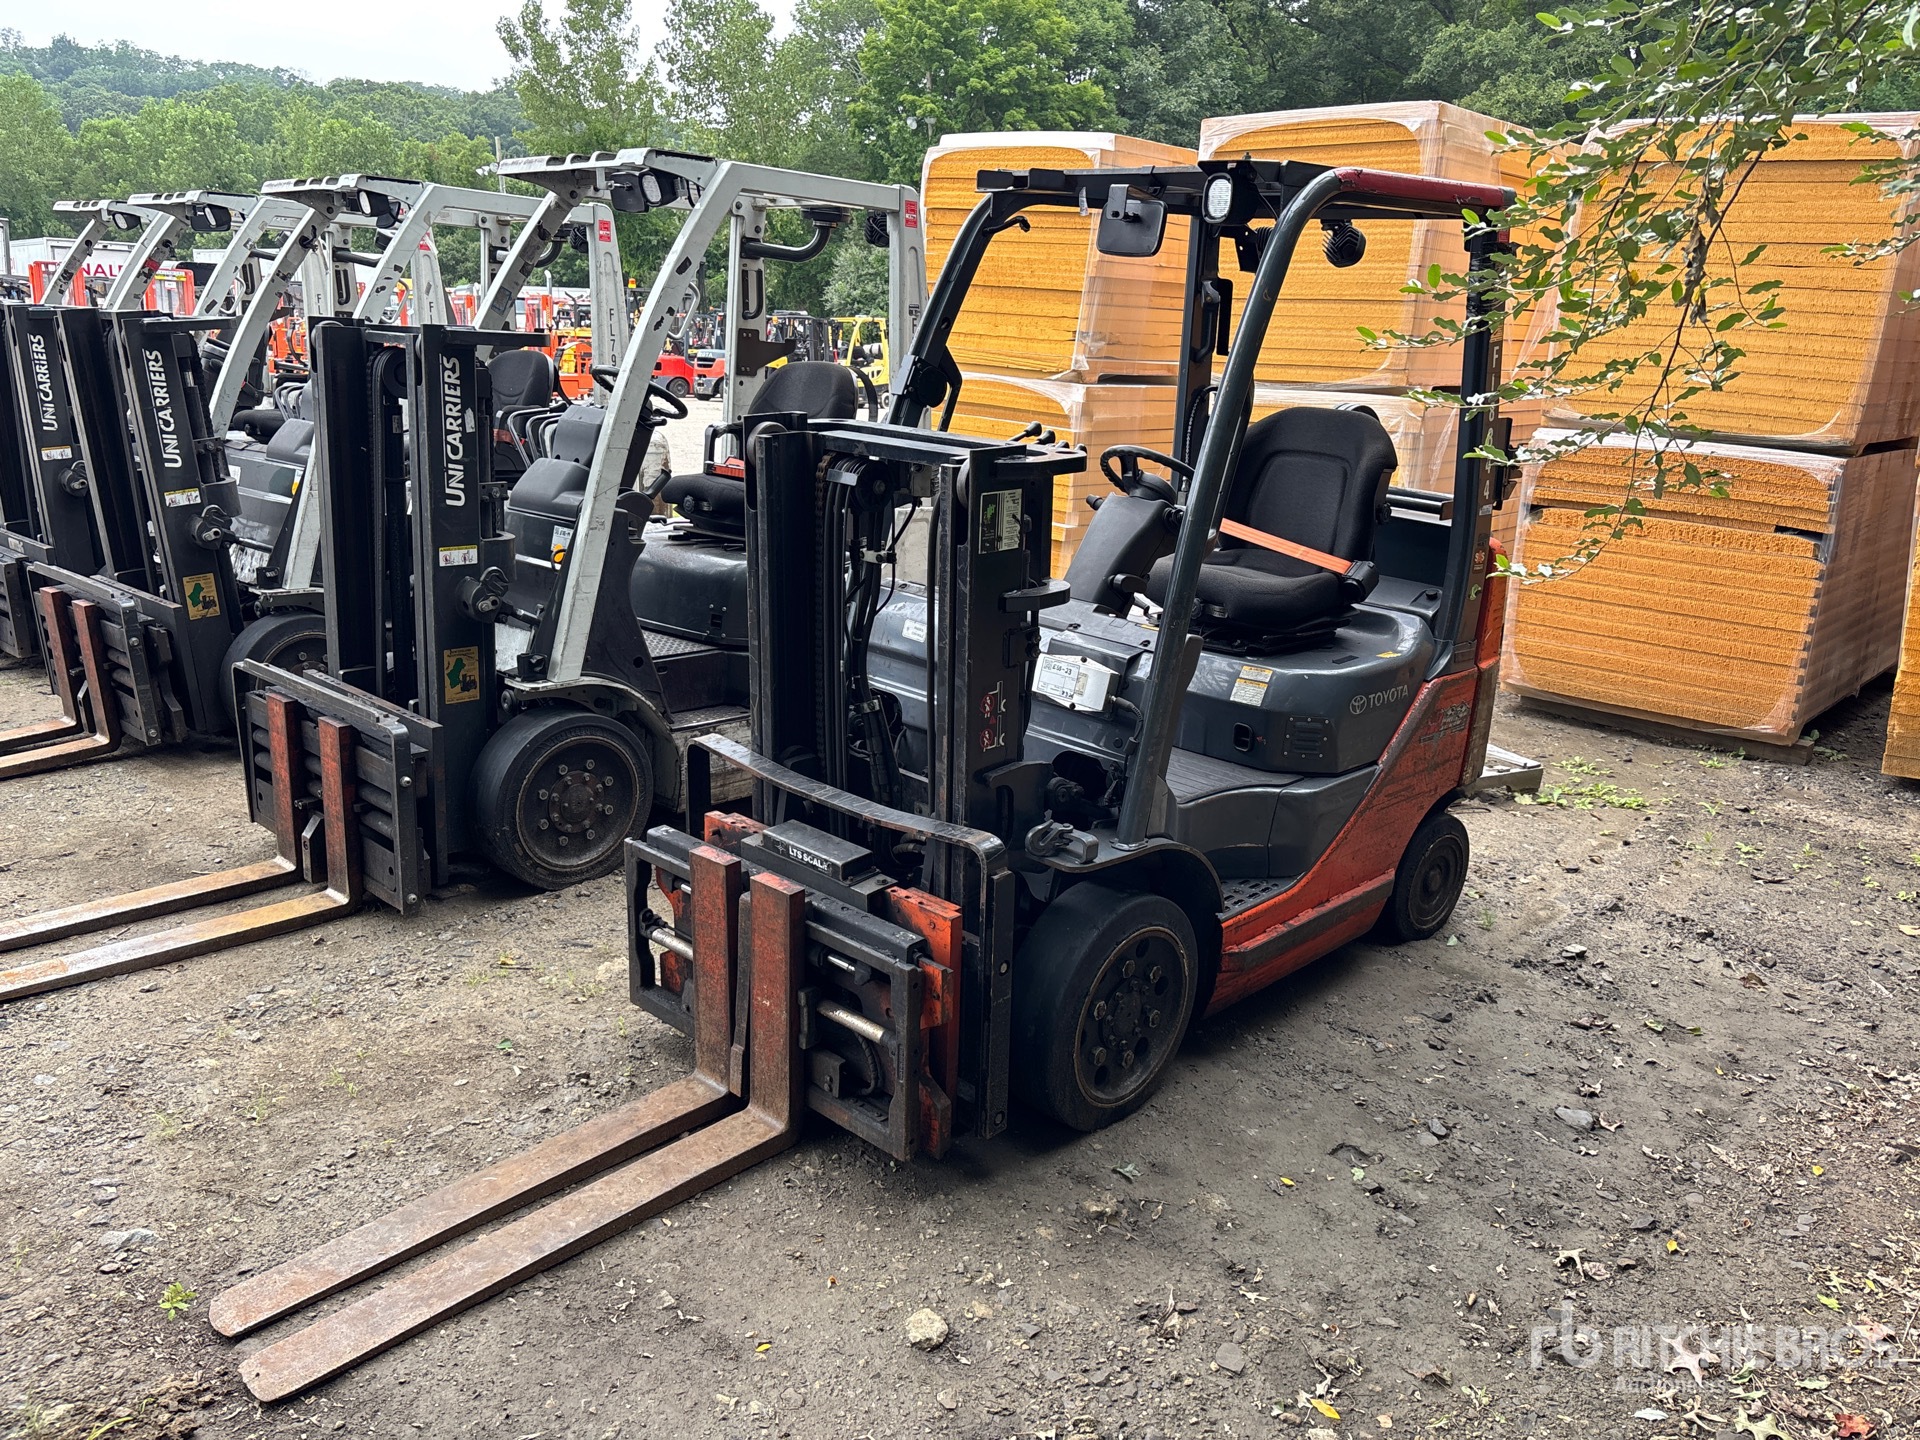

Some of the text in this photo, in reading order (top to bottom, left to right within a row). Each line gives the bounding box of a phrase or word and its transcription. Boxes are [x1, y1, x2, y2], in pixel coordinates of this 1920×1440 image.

[28, 333, 58, 431] UNICARRIERS
[142, 348, 182, 468] UNICARRIERS
[440, 353, 466, 507] UNICARRIERS
[1368, 685, 1409, 708] TOYOTA
[789, 845, 802, 859] LTS
